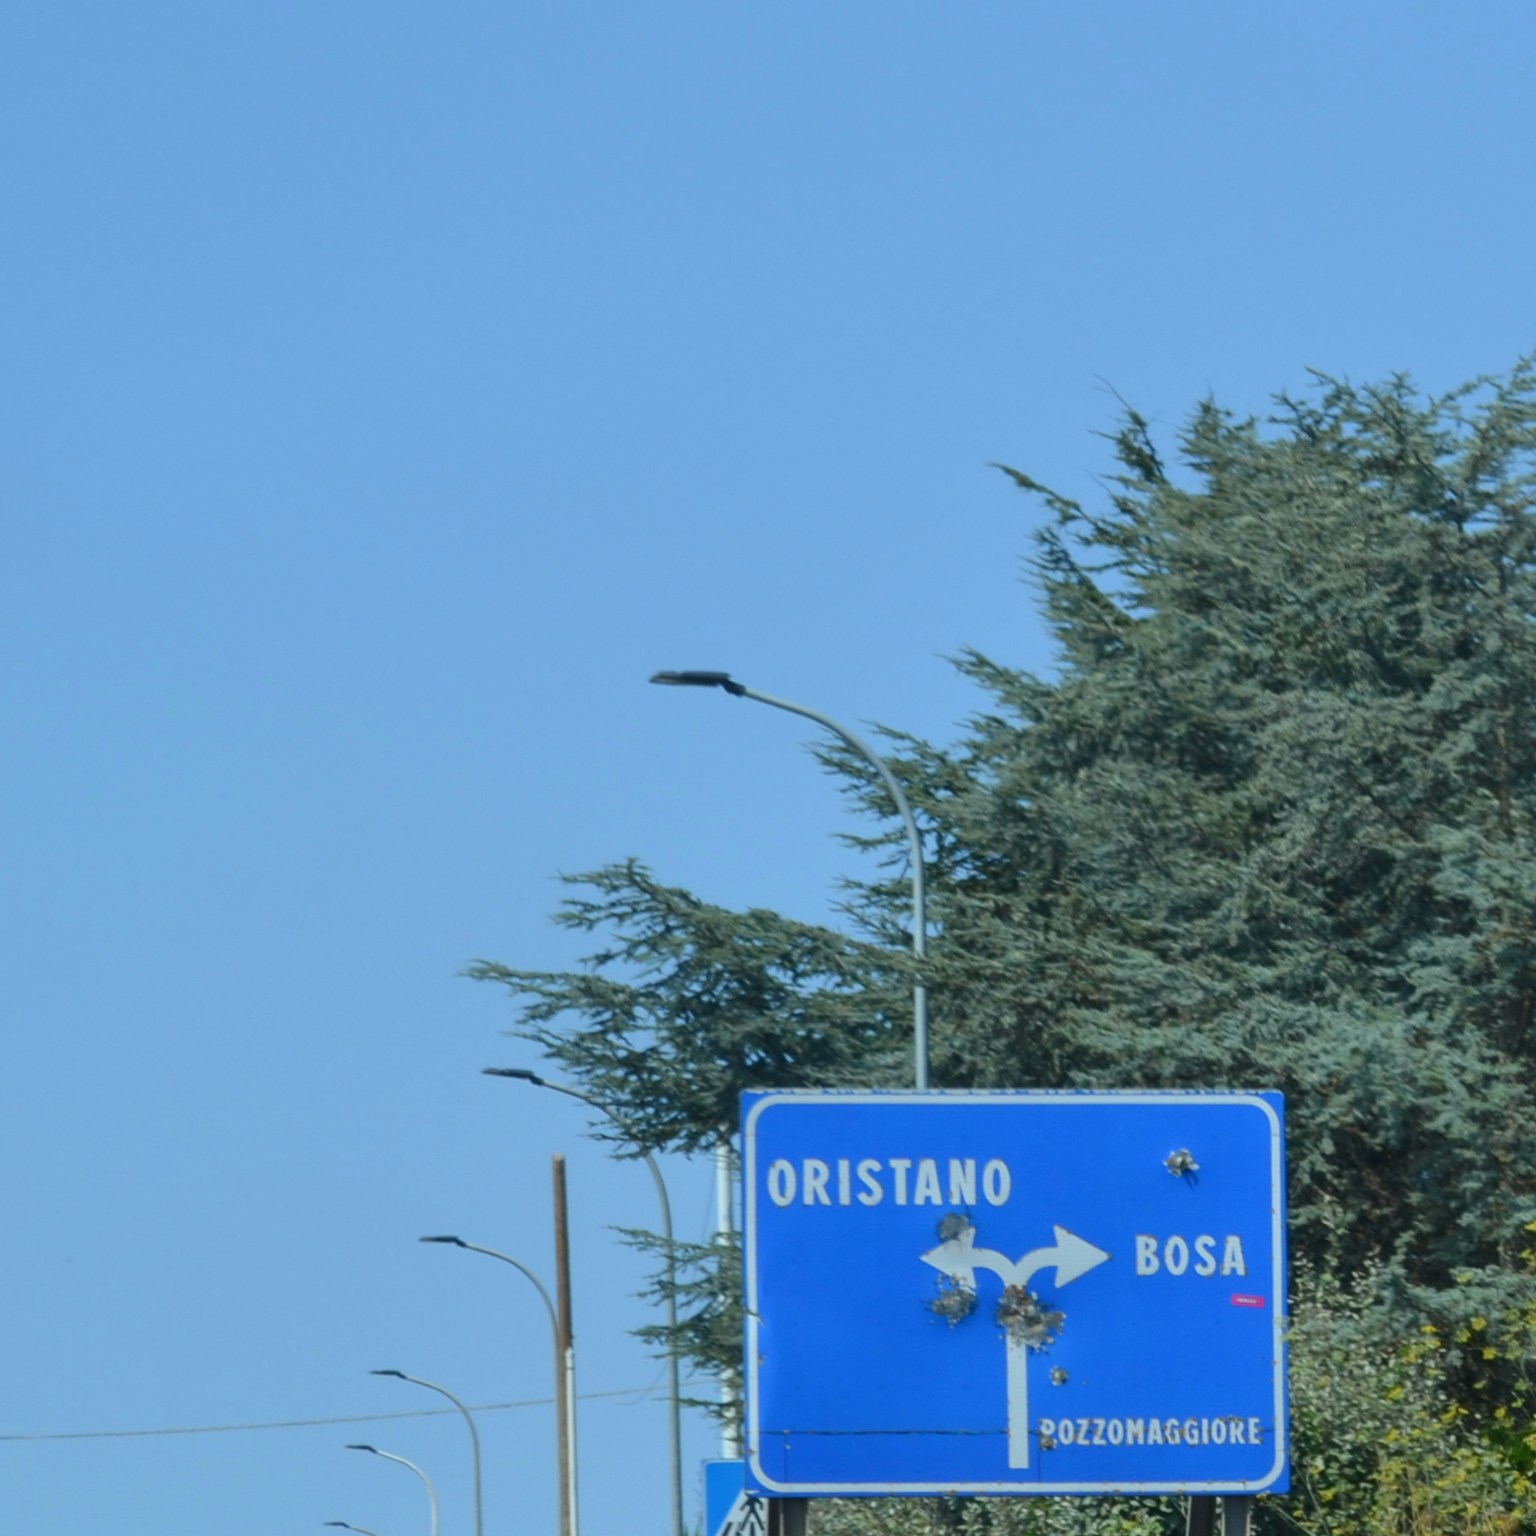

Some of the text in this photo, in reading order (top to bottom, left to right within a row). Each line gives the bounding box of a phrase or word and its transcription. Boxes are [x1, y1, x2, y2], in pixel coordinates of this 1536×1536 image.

[767, 1158, 1012, 1207] ORISTANO
[1135, 1234, 1248, 1277] BOSA
[1039, 1417, 1264, 1448] POZZOMAGGIORE
